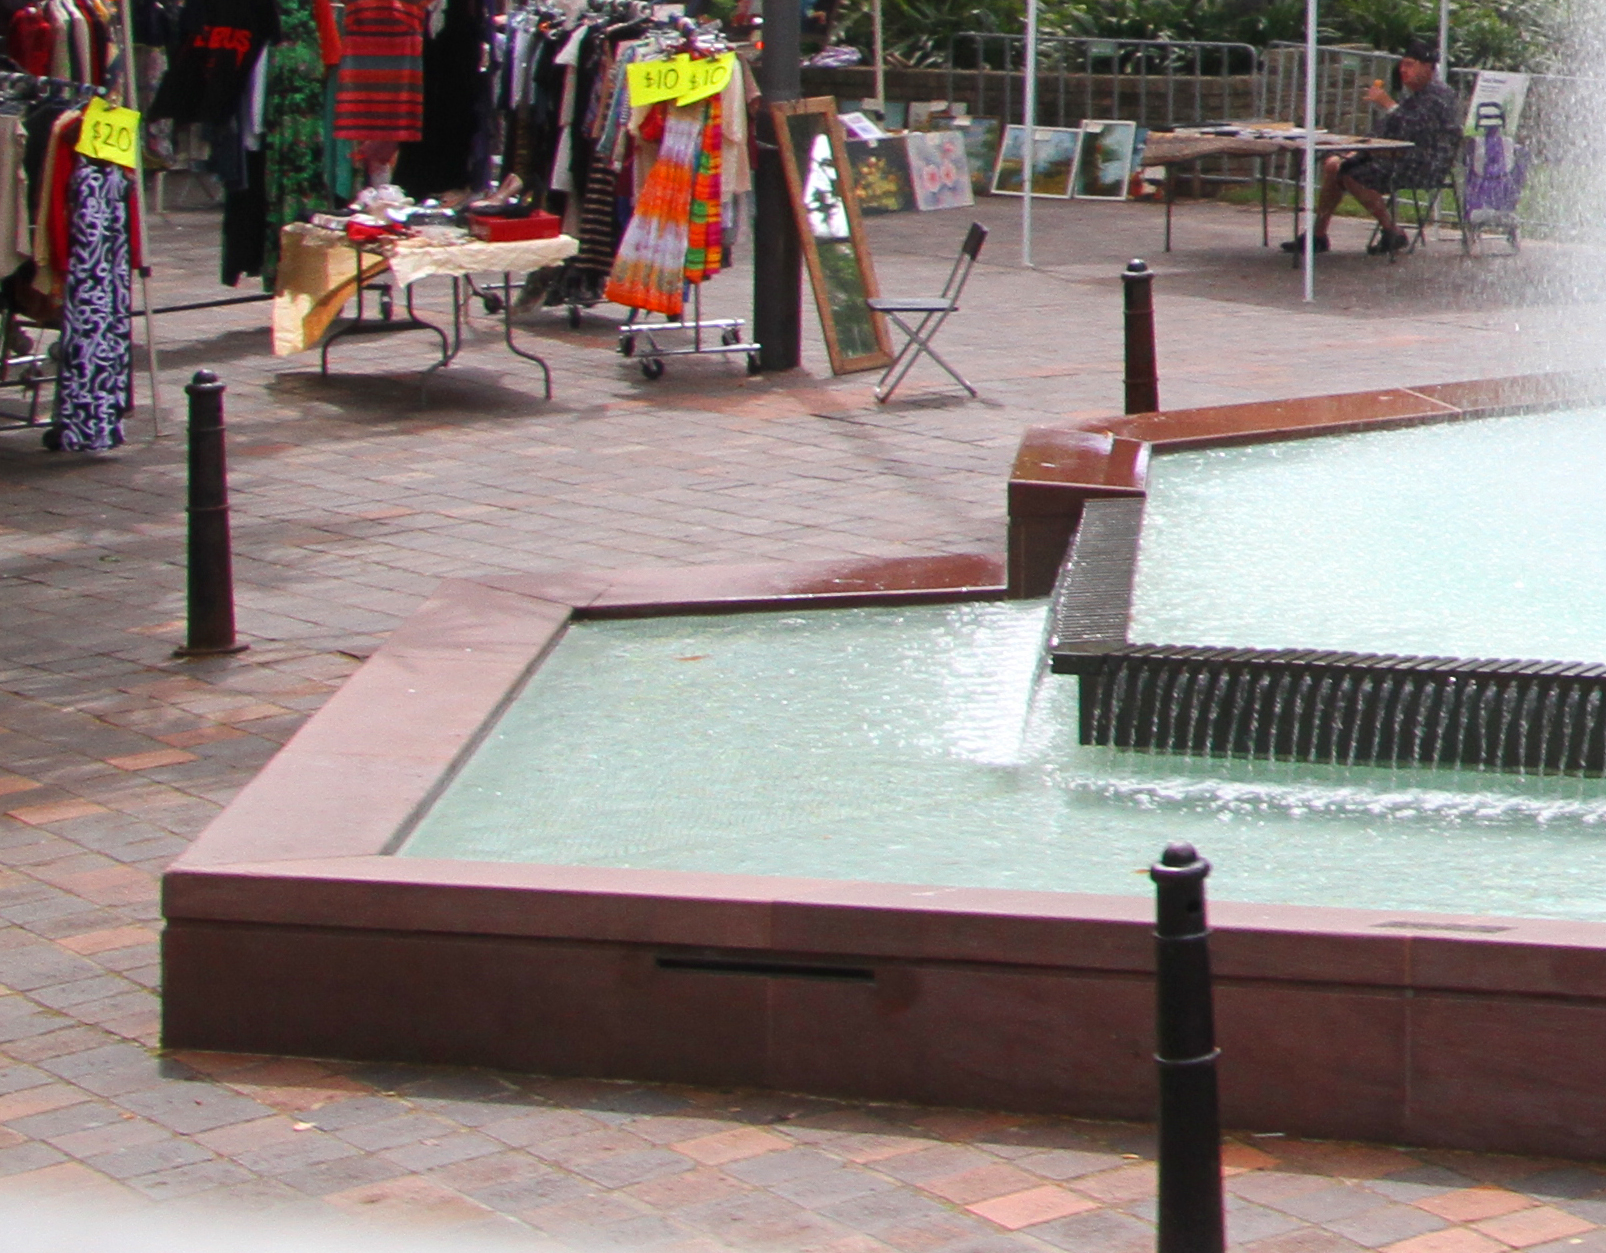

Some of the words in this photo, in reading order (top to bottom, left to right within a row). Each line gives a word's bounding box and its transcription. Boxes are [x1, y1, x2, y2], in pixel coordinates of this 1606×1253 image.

[644, 68, 679, 90] $10
[690, 66, 728, 91] $10
[92, 119, 132, 152] $20
